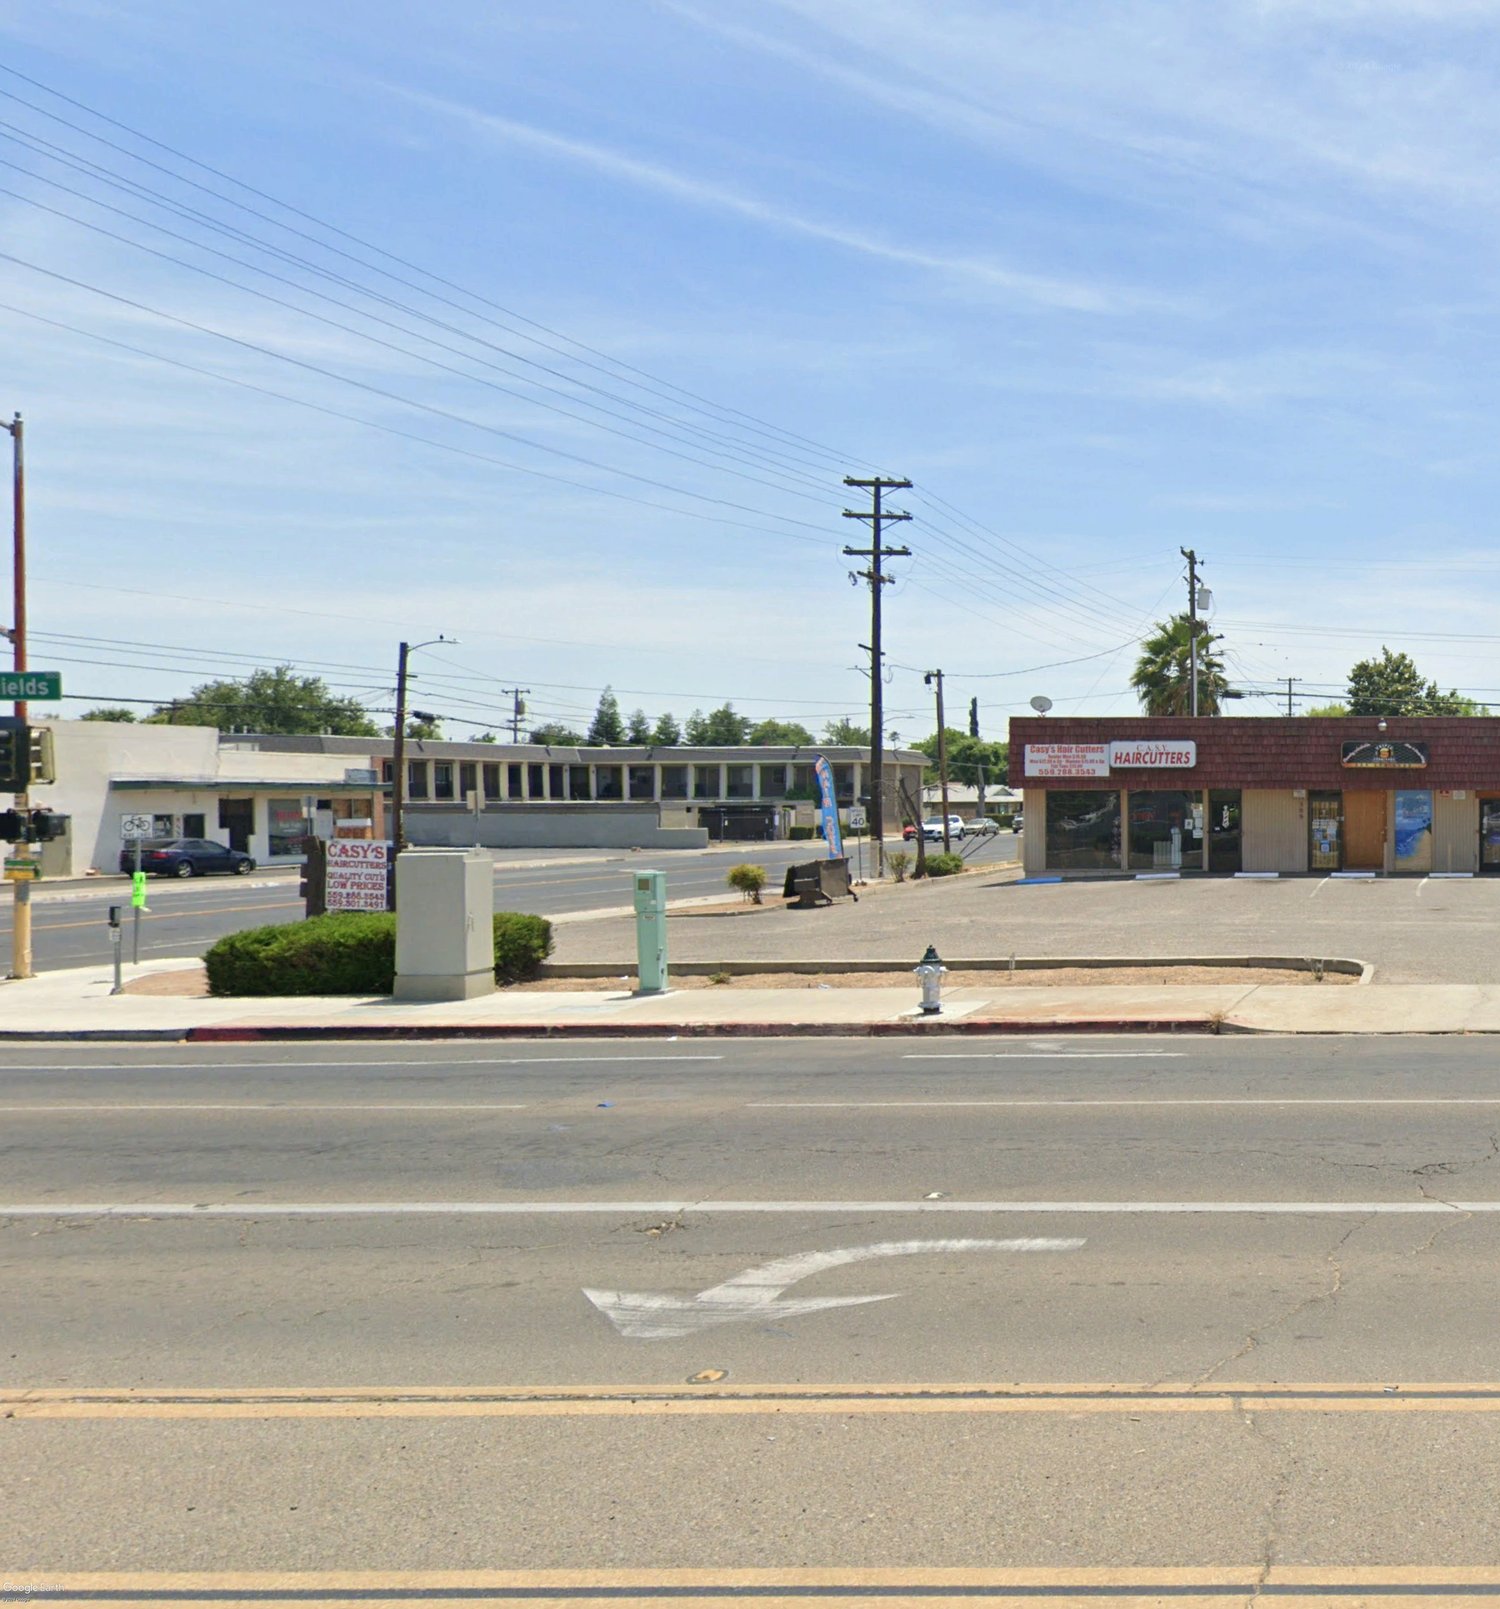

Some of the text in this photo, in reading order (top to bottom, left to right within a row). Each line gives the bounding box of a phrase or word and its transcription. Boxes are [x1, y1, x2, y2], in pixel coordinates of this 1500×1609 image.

[1057, 745, 1073, 753] Hair
[1075, 745, 1105, 753] Cutters
[1114, 751, 1191, 765] HAIRCUTTERS
[851, 817, 865, 826] 40
[328, 843, 385, 859] CASY'S
[327, 860, 388, 870] HAIRCUTTERS
[327, 872, 363, 881] QUALITY
[327, 880, 385, 891] LOW PRICES
